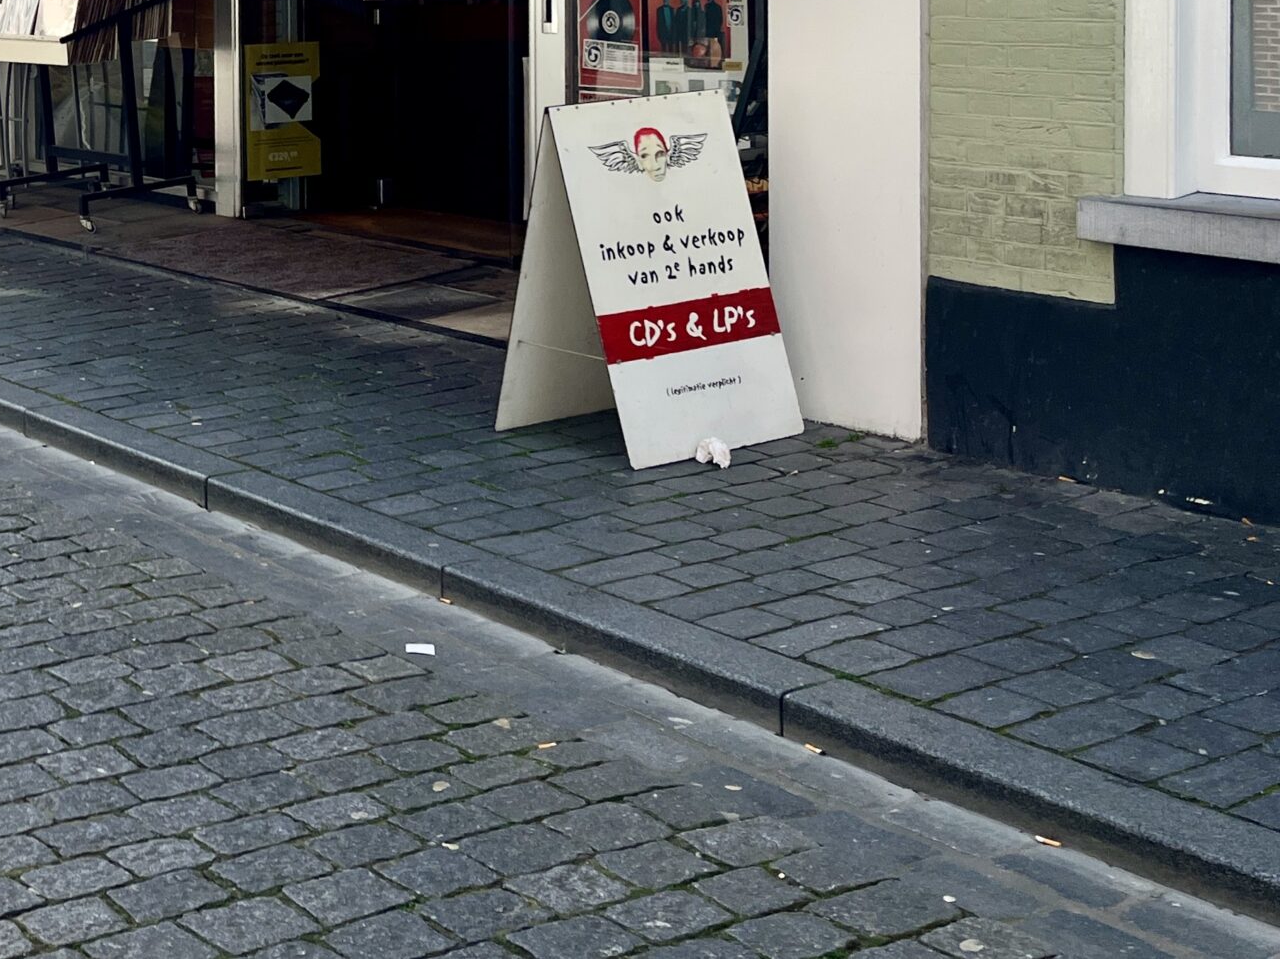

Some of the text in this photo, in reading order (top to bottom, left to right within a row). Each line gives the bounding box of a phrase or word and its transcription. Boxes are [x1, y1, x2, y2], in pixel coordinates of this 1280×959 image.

[652, 204, 685, 224] ook
[599, 228, 745, 261] inkoop & verkoop
[627, 269, 659, 285] van
[688, 255, 734, 277] hands
[629, 305, 757, 347] CD's & LP's
